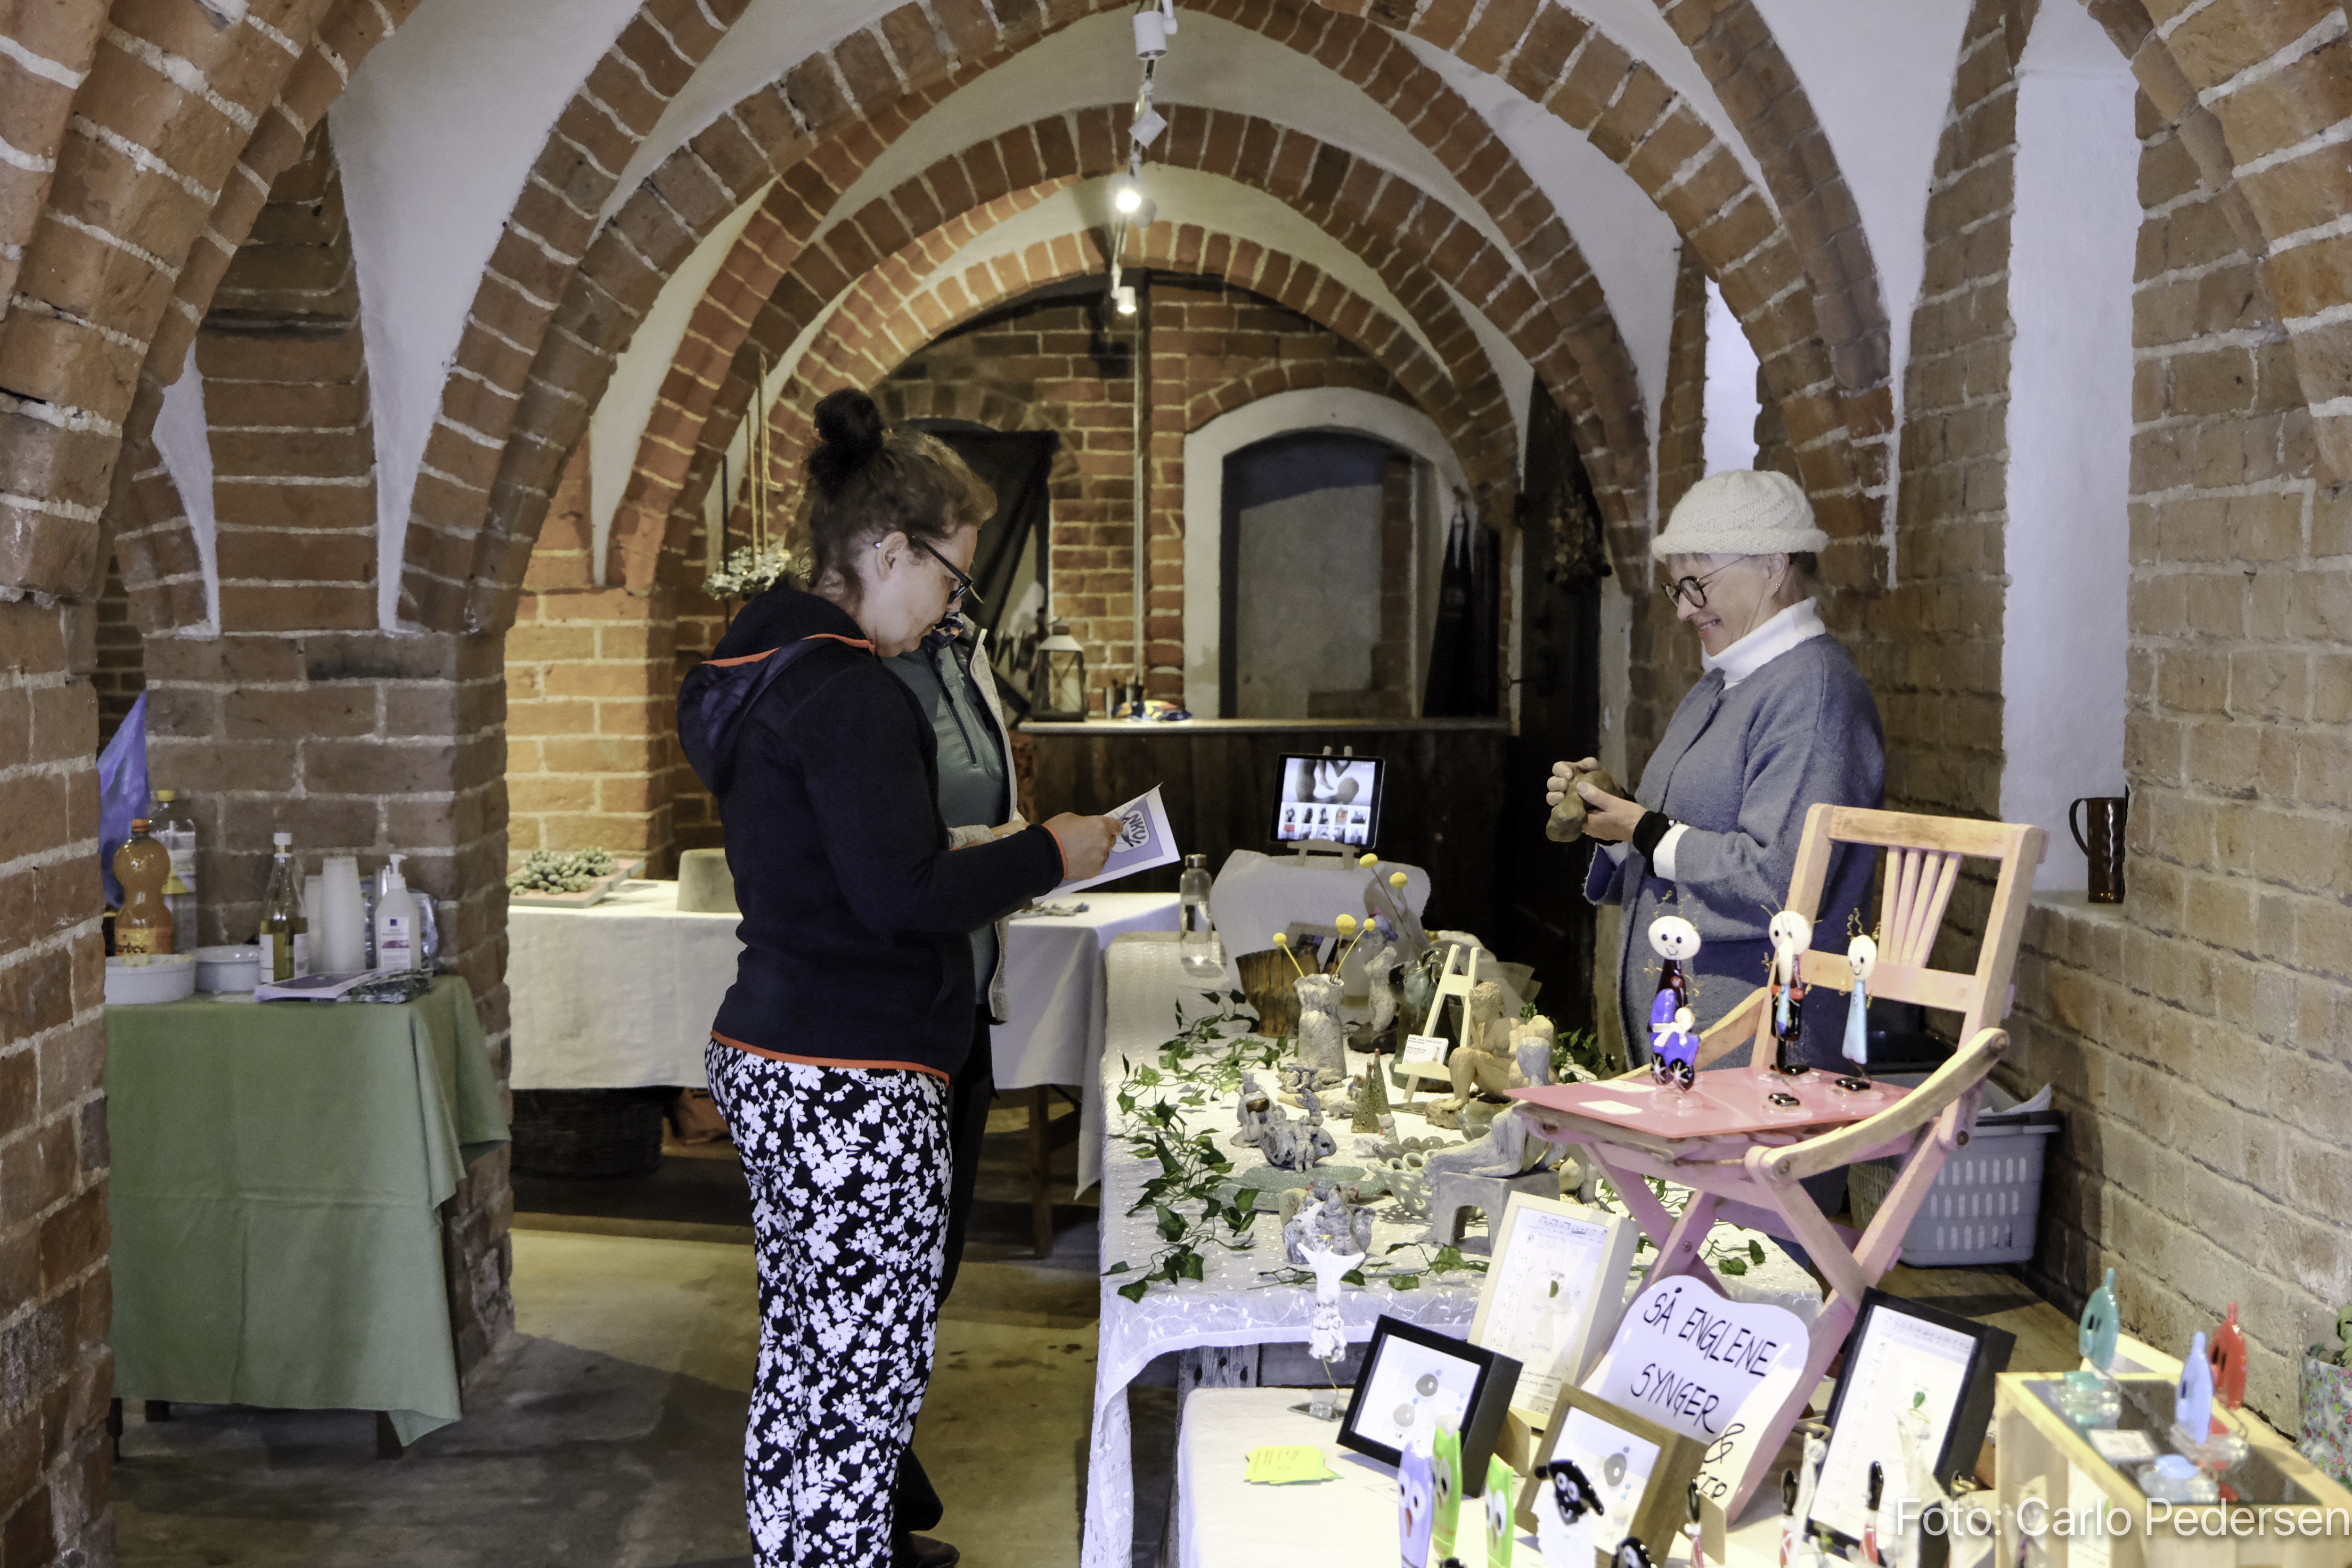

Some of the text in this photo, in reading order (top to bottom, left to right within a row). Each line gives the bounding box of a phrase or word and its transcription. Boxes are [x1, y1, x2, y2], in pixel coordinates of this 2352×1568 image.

[1643, 1287, 1777, 1377] SÅ ENGLENE
[1631, 1363, 1719, 1434] SYNGER
